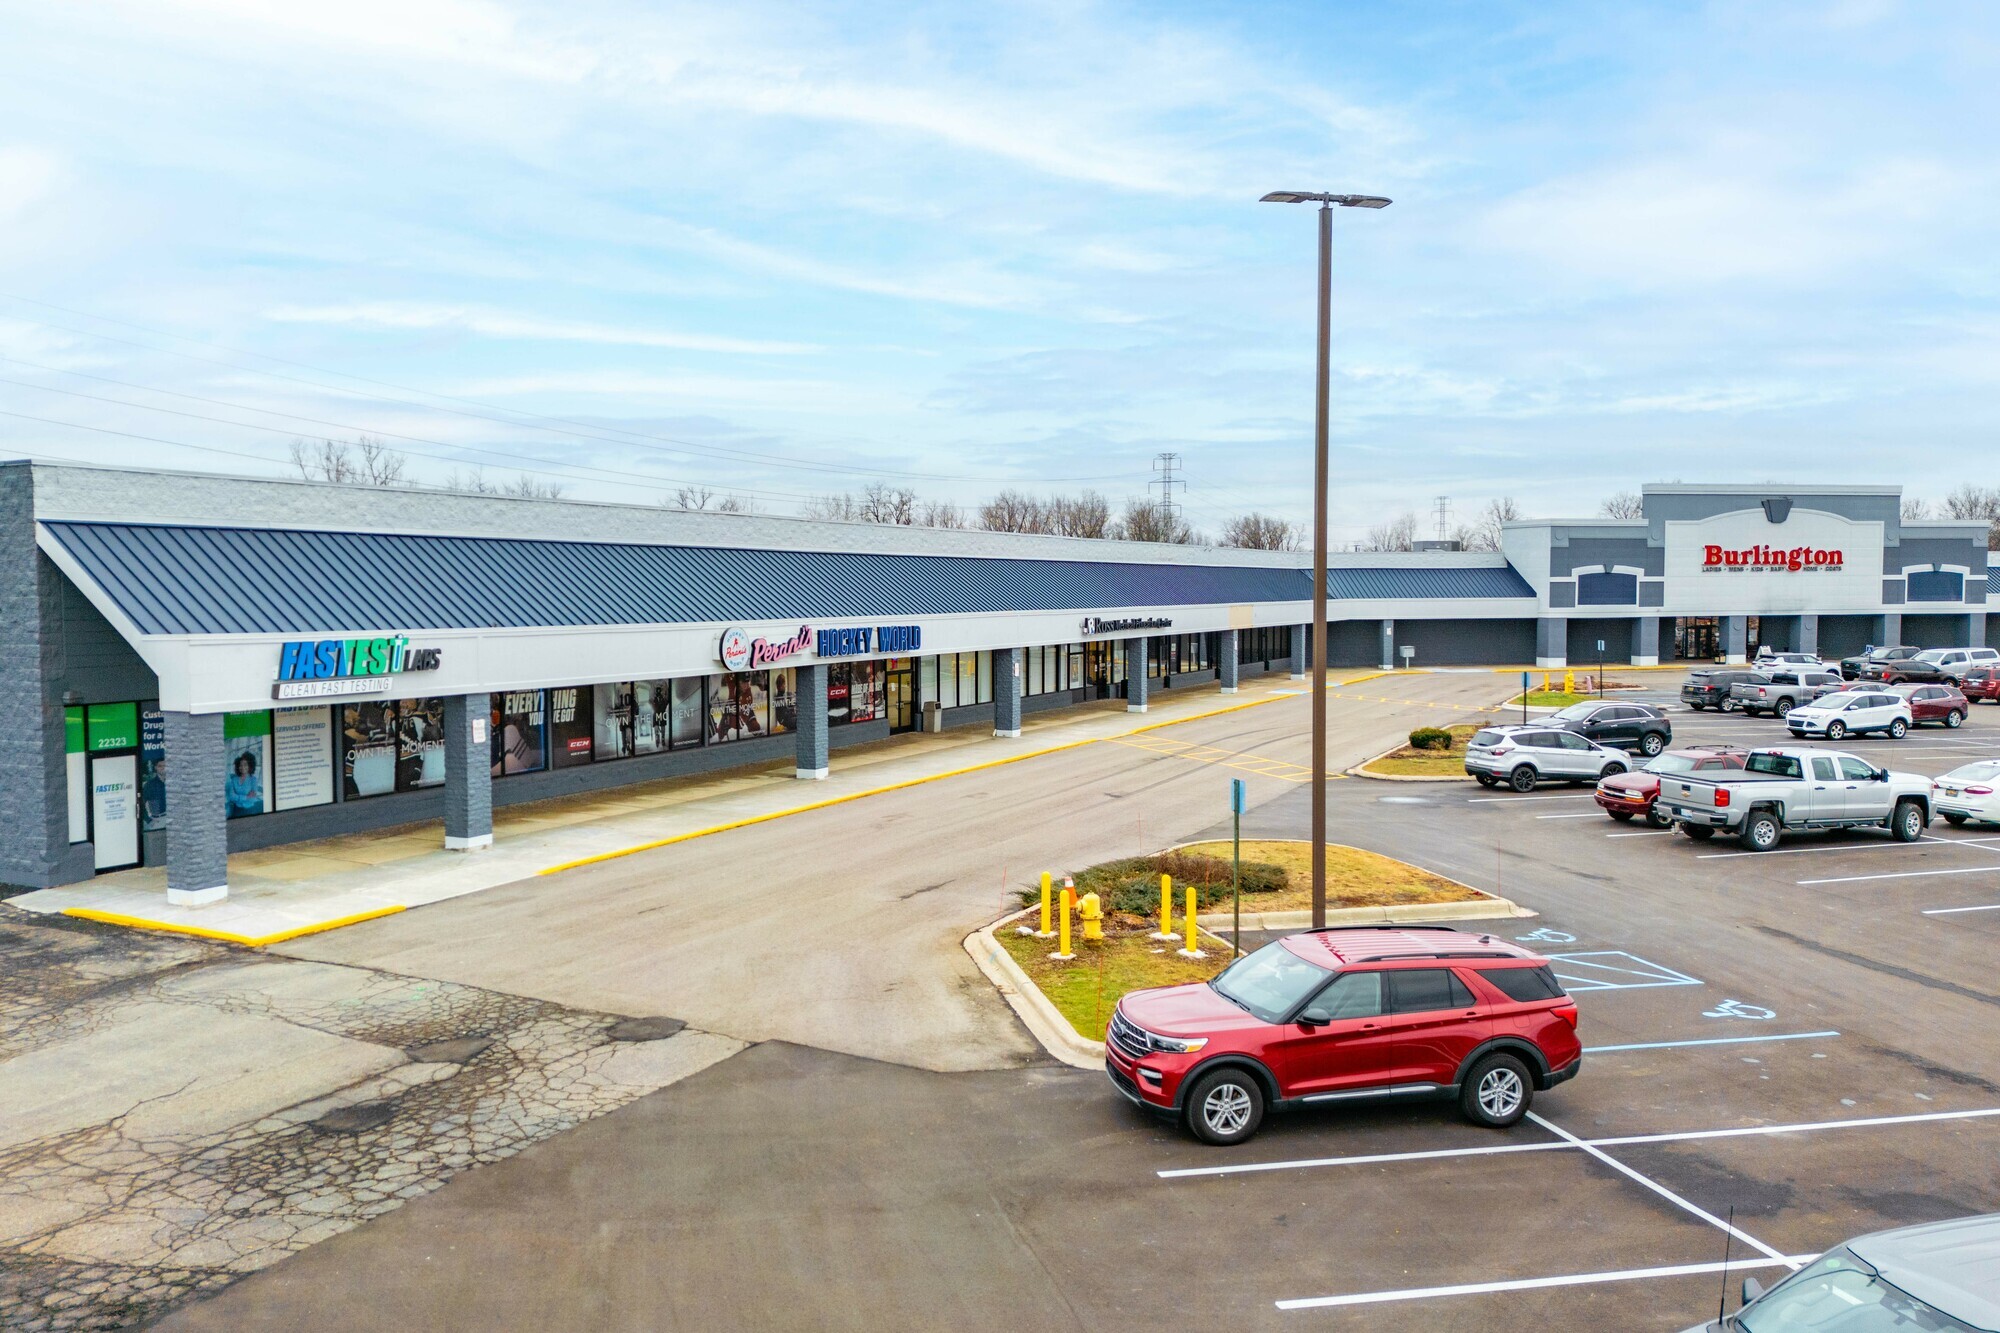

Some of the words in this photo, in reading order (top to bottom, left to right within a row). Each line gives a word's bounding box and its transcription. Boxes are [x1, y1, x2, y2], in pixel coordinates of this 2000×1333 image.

[1703, 544, 1843, 572] Burlington
[817, 627, 873, 657] HOCKEY
[877, 625, 921, 652] WORLD
[403, 648, 441, 672] LABS
[283, 683, 317, 697] CLEAN
[321, 681, 346, 693] FAST
[350, 678, 389, 692] TESTING
[726, 704, 737, 713] THE
[561, 708, 576, 722] GOT
[605, 716, 629, 728] OWN
[634, 713, 651, 722] THE
[143, 721, 164, 731] Drug
[276, 724, 301, 733] SERVICES
[302, 722, 326, 730] OFFERED
[143, 731, 155, 741] for
[157, 731, 162, 739] a
[98, 737, 127, 748] 22323
[570, 740, 590, 748] CCM
[347, 748, 374, 760] OWN
[375, 746, 395, 756] THE
[401, 739, 445, 754] MOMENT
[95, 782, 125, 793] FASTEST
